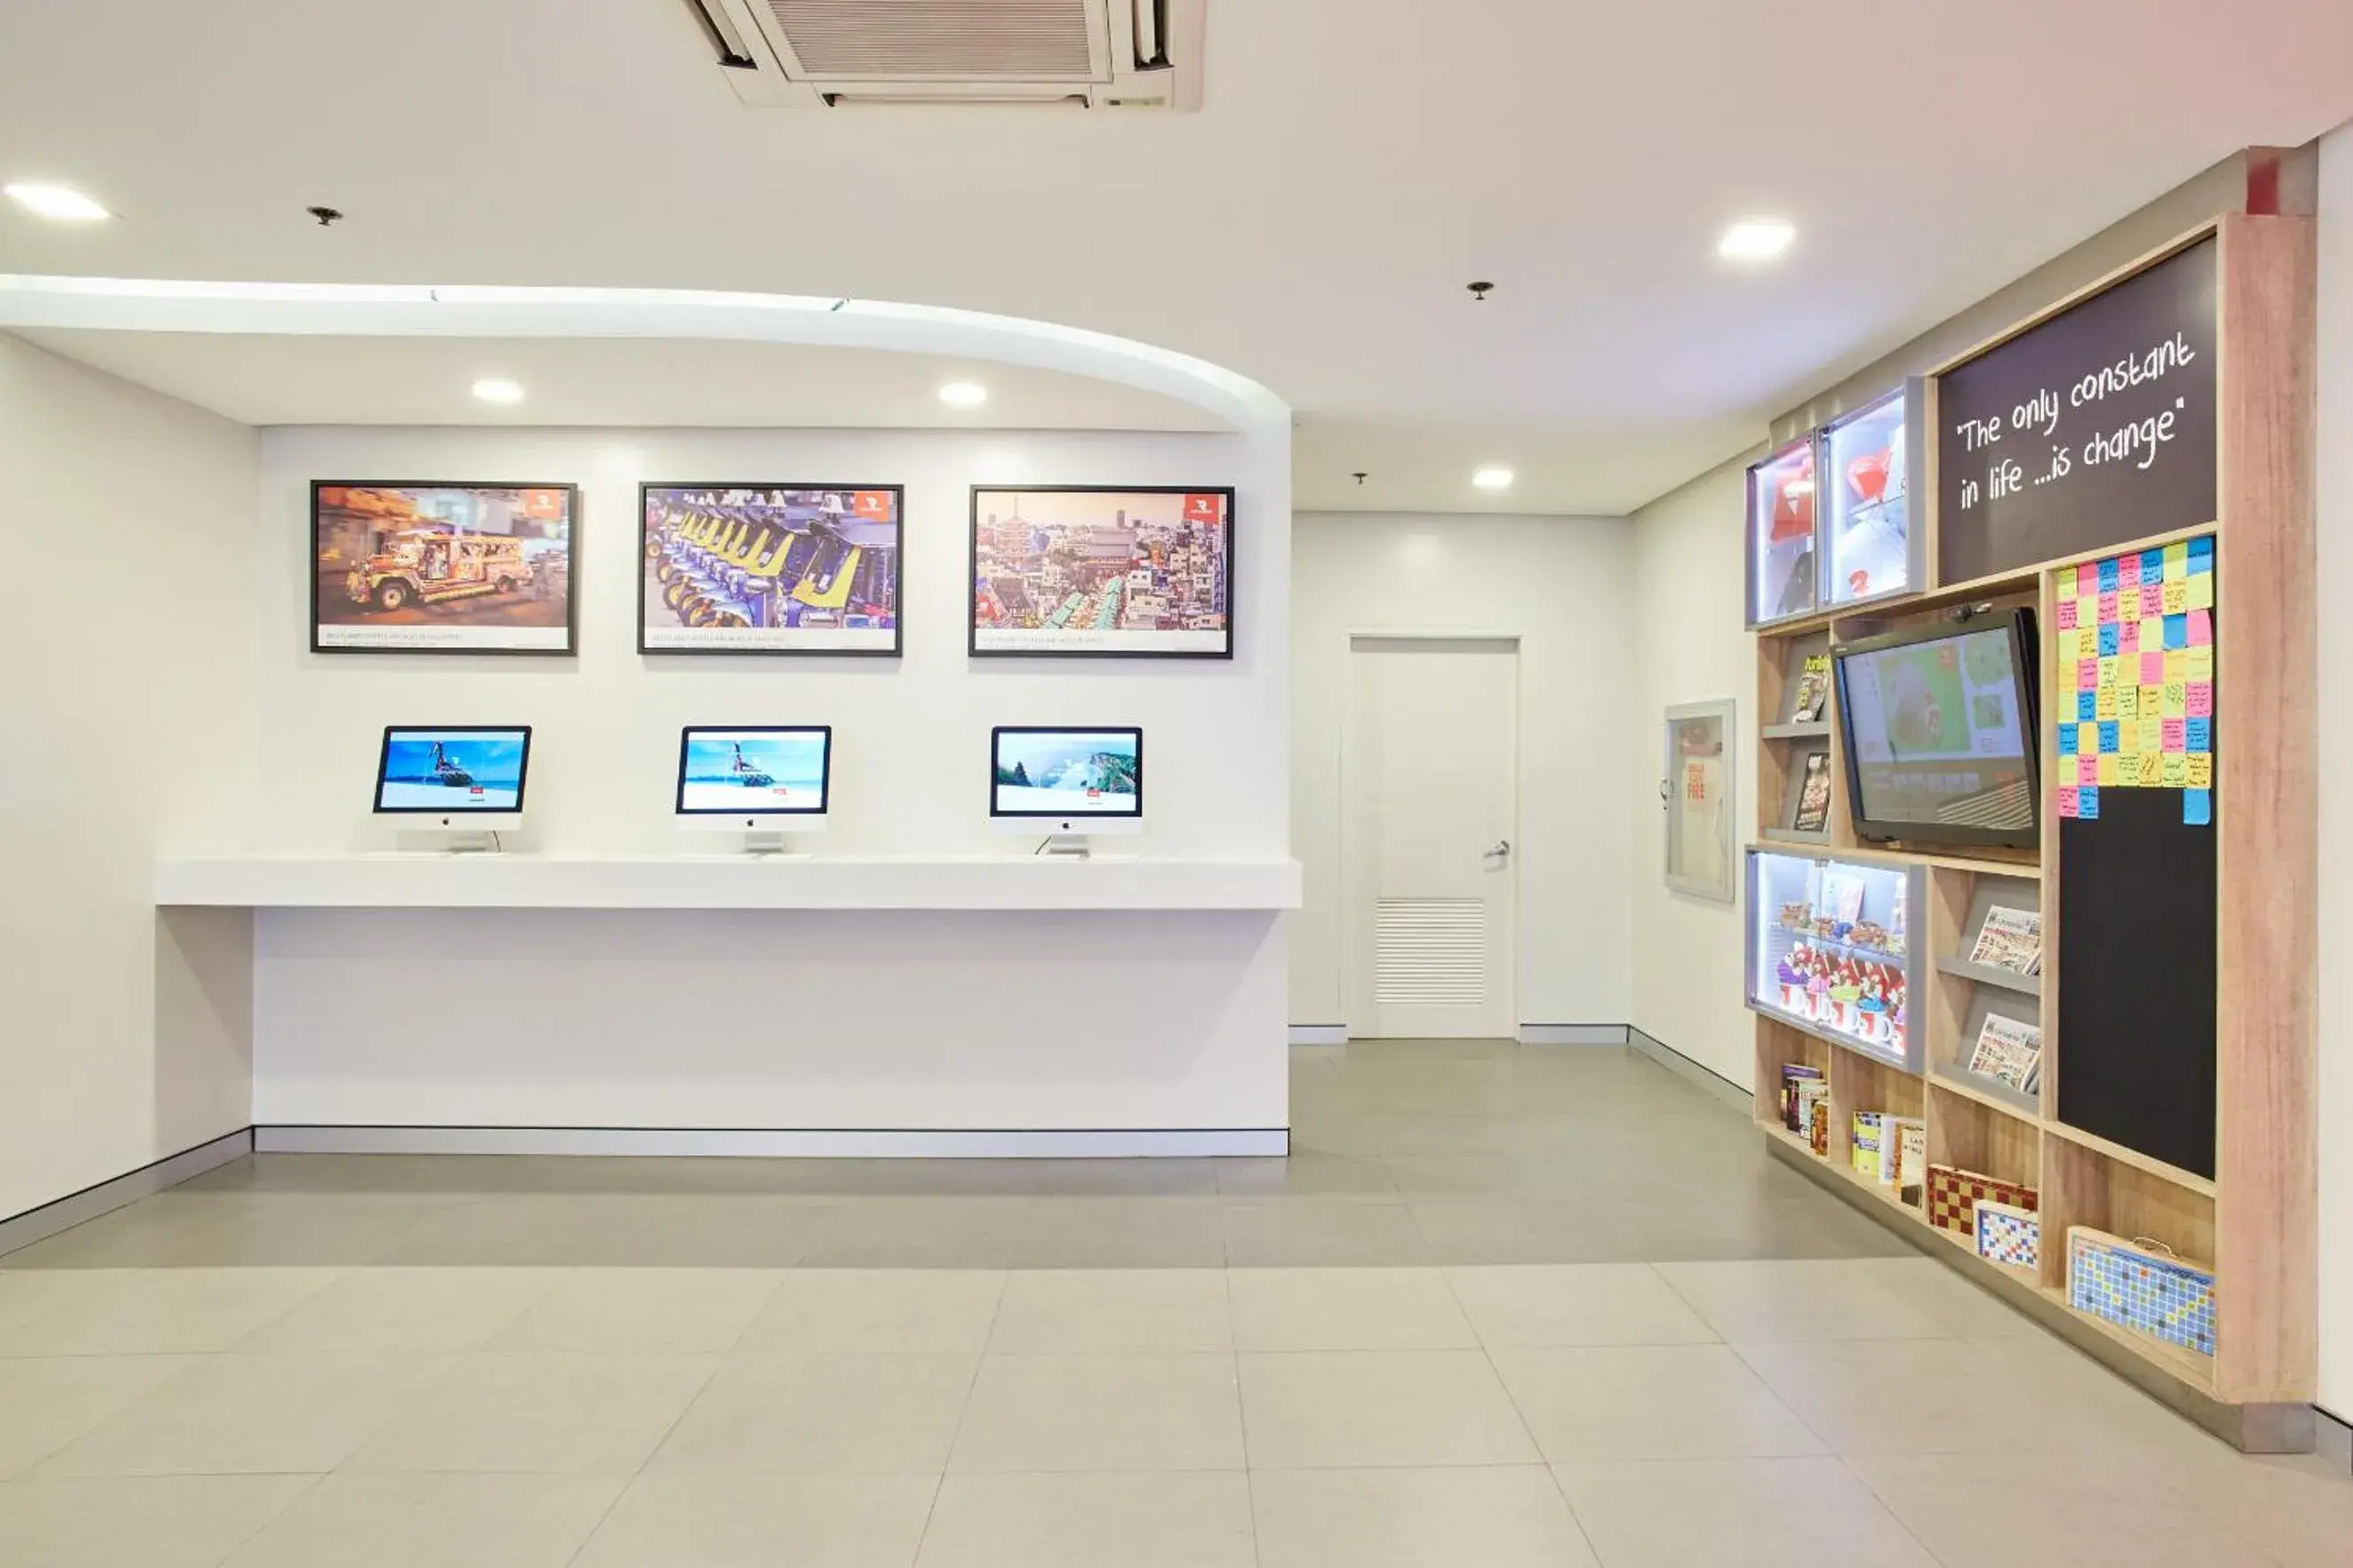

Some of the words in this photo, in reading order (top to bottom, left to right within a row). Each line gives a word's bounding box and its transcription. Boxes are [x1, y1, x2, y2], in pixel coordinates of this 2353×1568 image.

[2012, 389, 2059, 436] only
[2070, 331, 2196, 406] constant
[1961, 479, 1979, 510] in
[1990, 458, 2023, 500] life
[1687, 783, 1705, 800] FIRE
